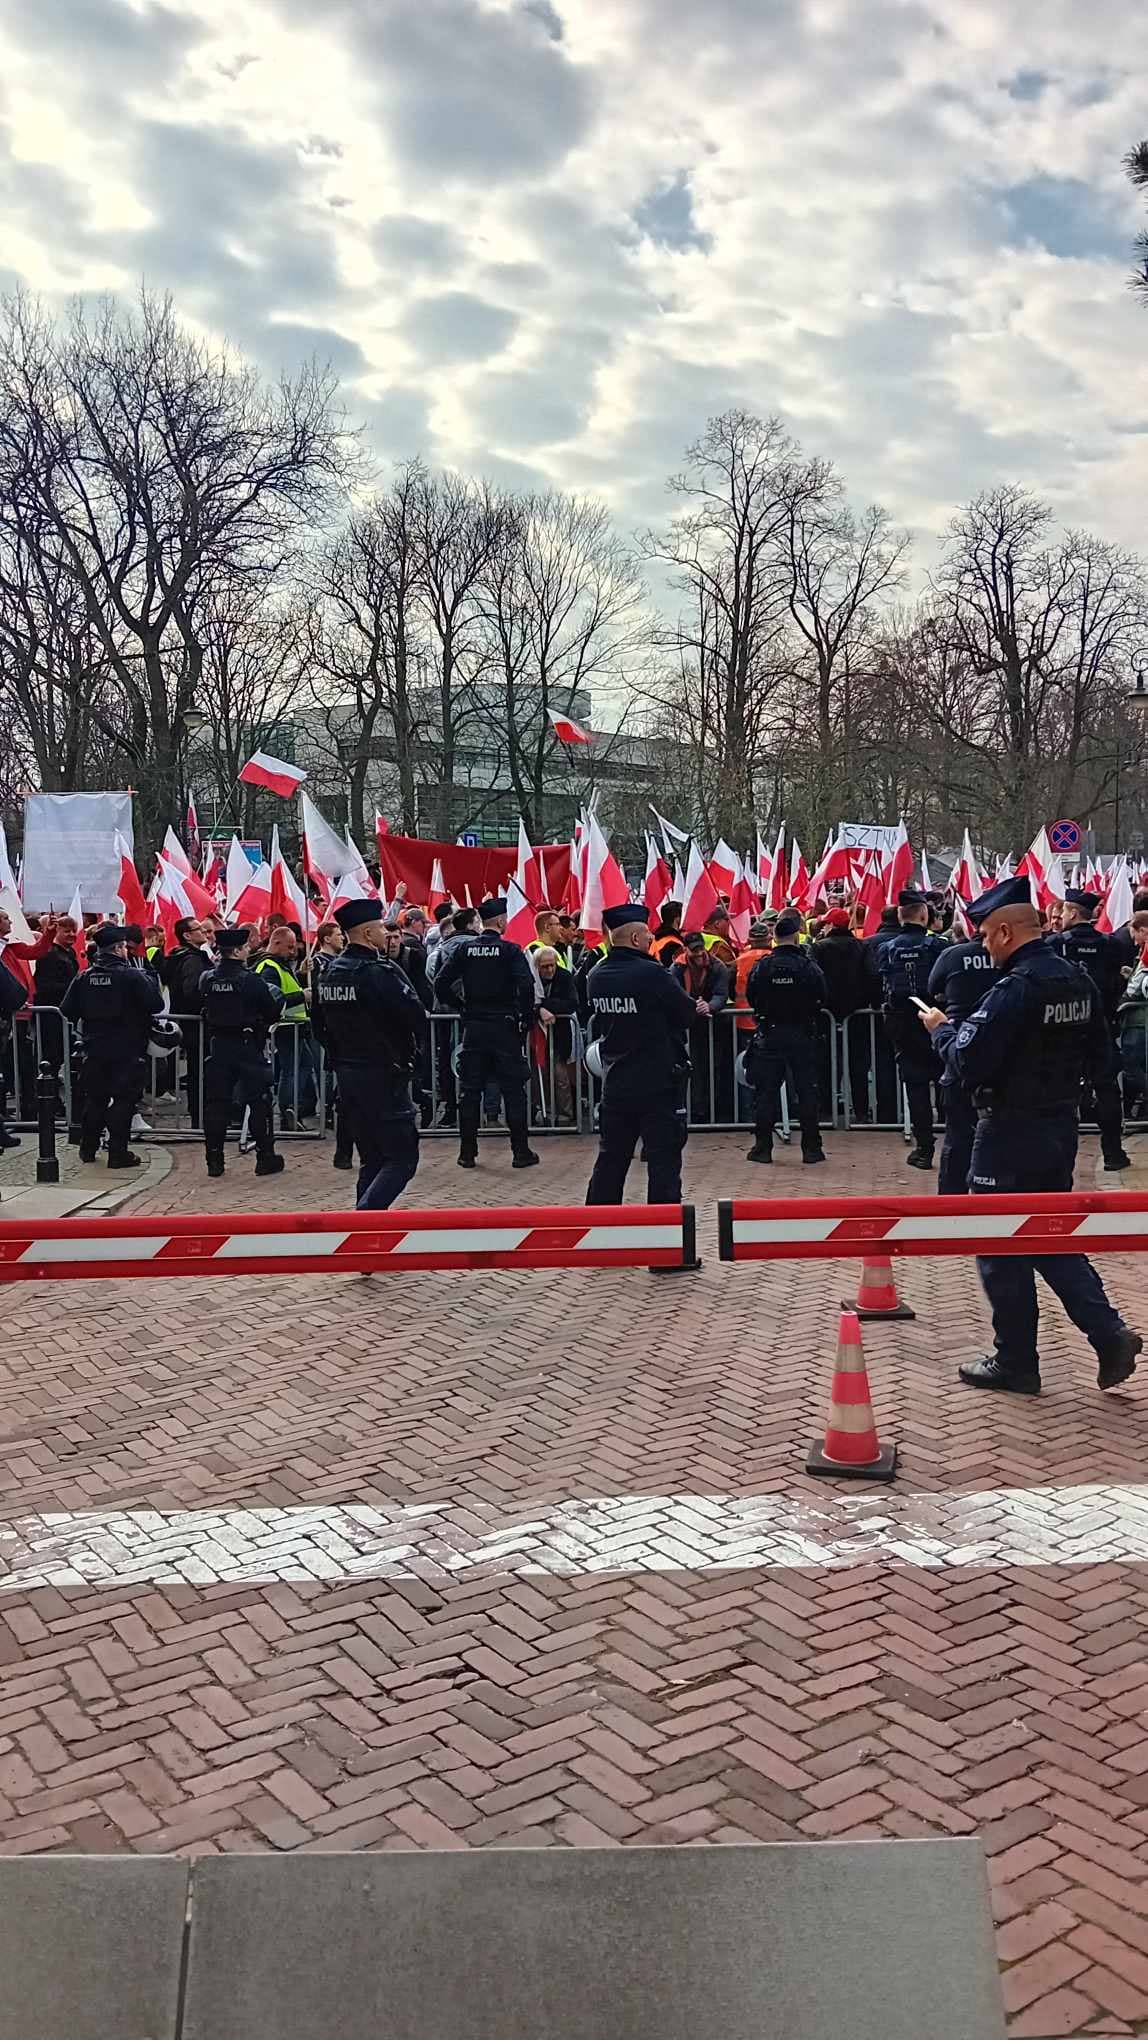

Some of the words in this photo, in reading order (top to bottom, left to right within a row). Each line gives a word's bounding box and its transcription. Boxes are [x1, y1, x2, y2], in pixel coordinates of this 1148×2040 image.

[467, 946, 500, 957] POLICJA
[963, 955, 994, 970] POLI
[89, 977, 111, 986] POLICJA
[319, 986, 357, 1001] POLICJA
[592, 997, 638, 1014] POLICJA
[1043, 1000, 1091, 1024] POLICJA
